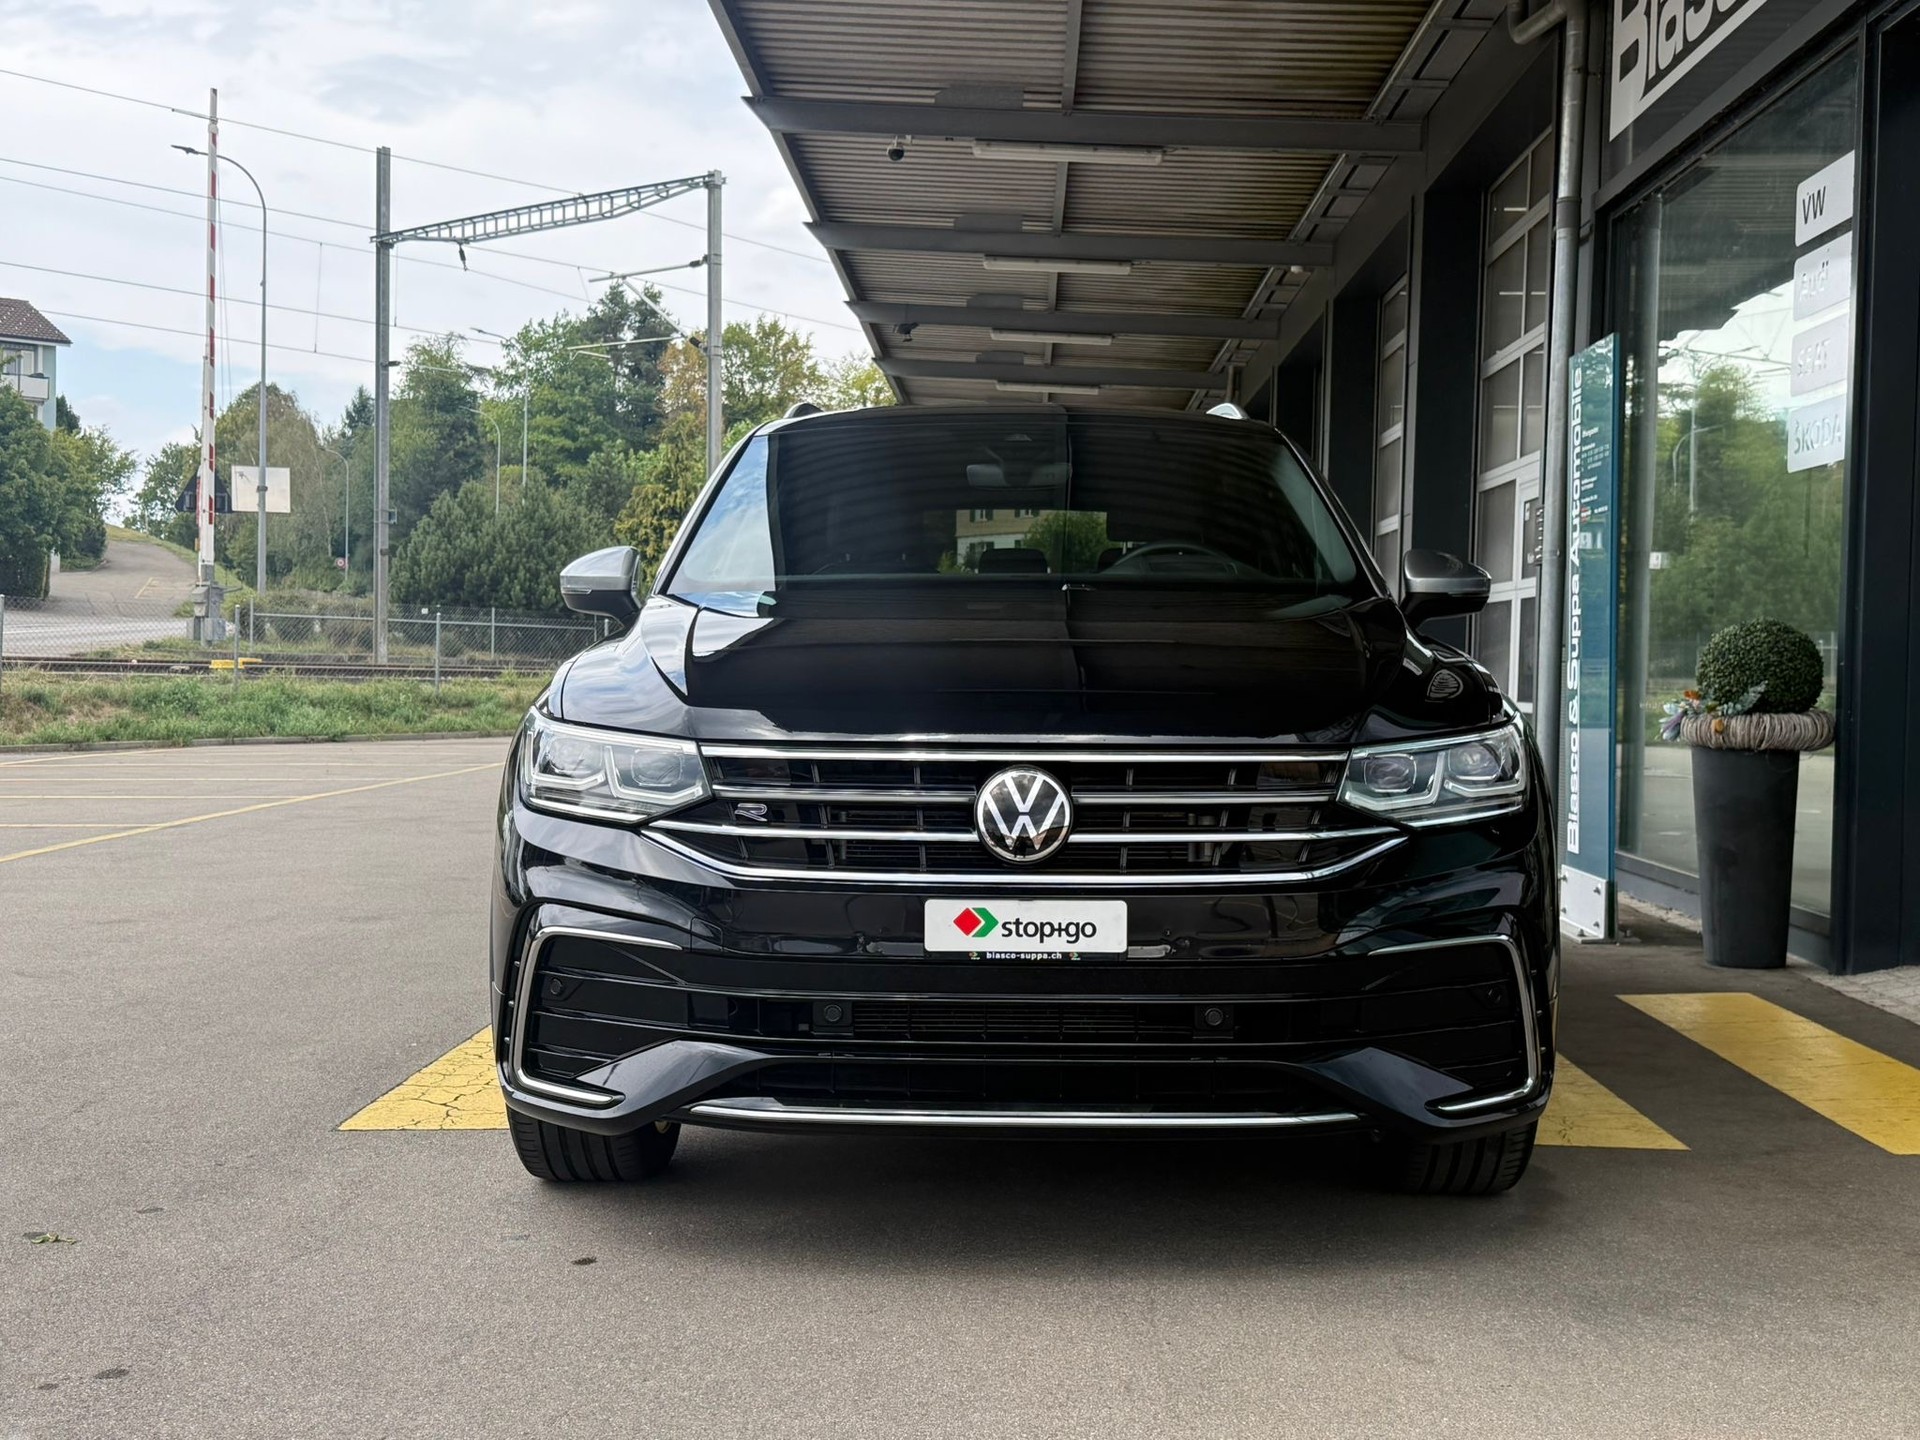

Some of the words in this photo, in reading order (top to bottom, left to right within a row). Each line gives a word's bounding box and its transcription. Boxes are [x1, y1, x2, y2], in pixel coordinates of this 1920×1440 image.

[1802, 185, 1827, 225] VW
[1570, 367, 1582, 567] Automobile
[1567, 573, 1582, 690] Suppa
[1568, 695, 1580, 725] &
[1001, 917, 1097, 944] stop+go
